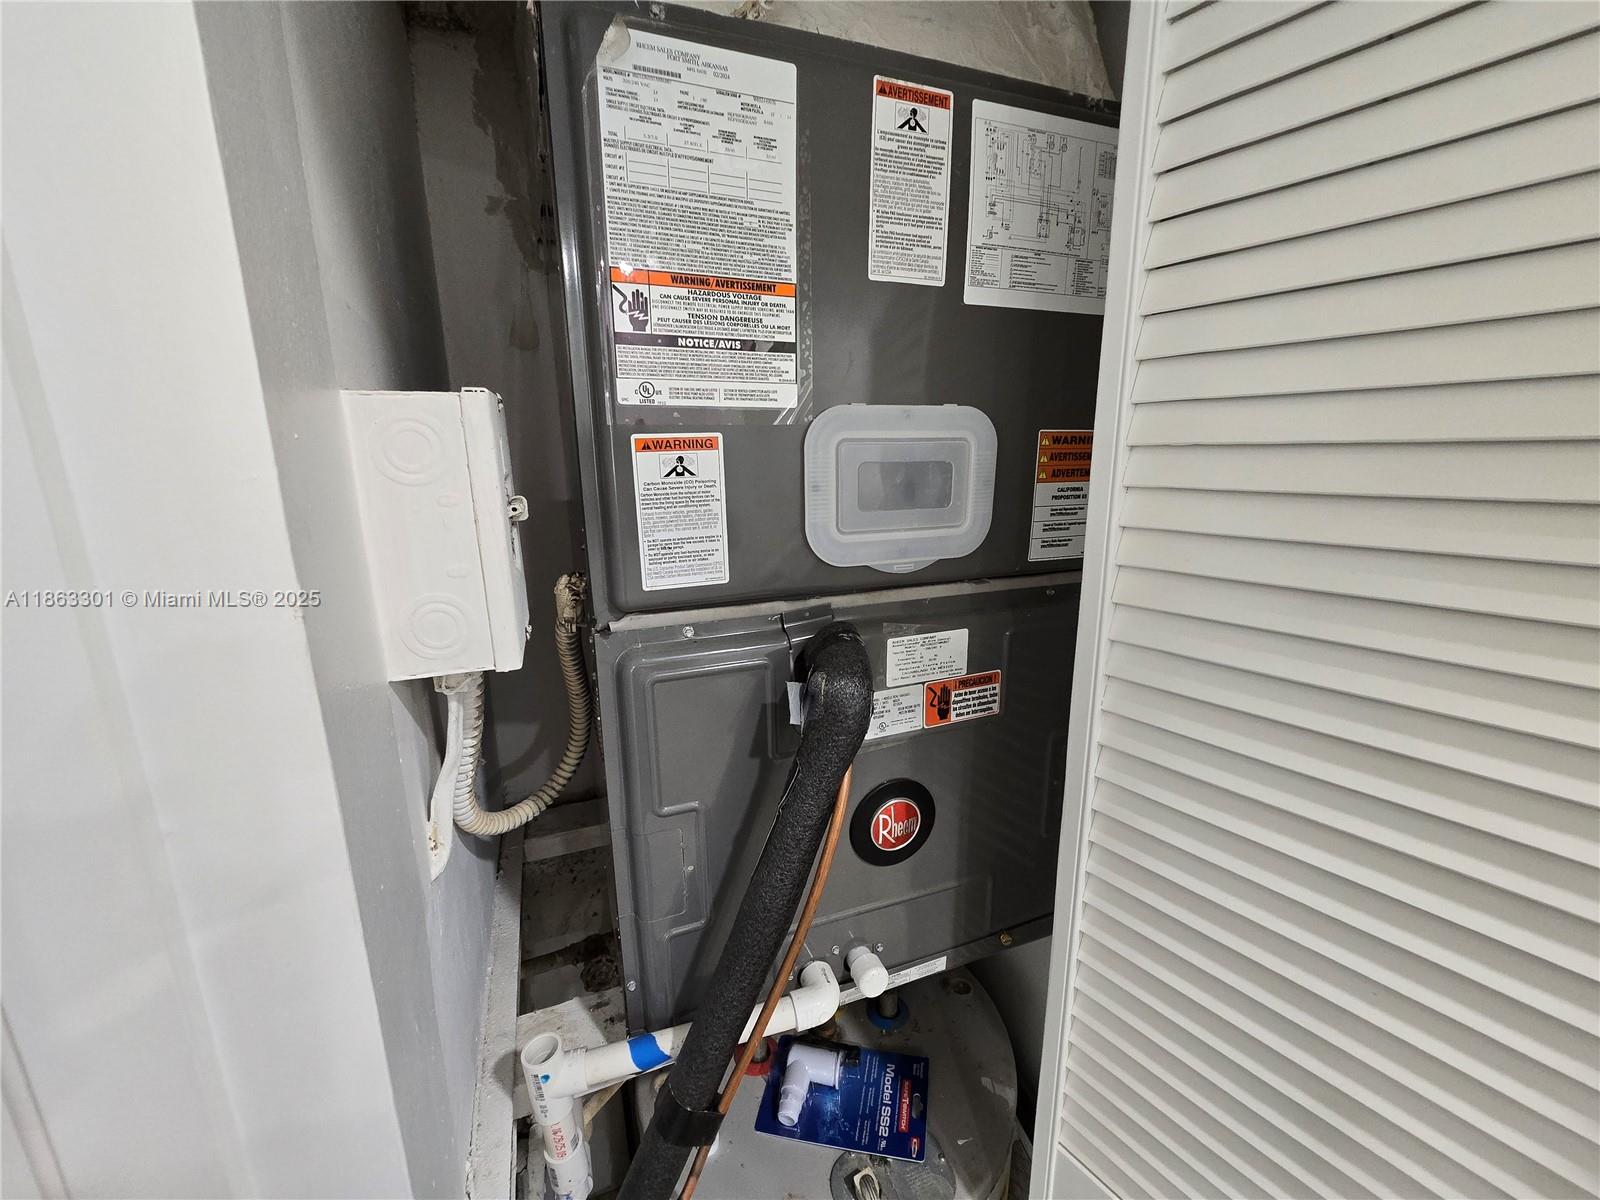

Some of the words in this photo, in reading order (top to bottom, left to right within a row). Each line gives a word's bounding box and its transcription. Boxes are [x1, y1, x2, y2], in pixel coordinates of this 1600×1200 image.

[888, 84, 948, 108] AVERTISSEMENT
[671, 275, 776, 293] WARNING/AVERTISSEMENT
[688, 289, 731, 299] HAZARDOUS
[733, 292, 761, 301] VOLTAGE
[687, 313, 718, 321] TENSION
[720, 315, 763, 324] DANGEREUSE
[726, 321, 760, 329] CORPORELLES
[678, 337, 741, 349] NOTICE/AVIS
[652, 439, 713, 449] WARNING
[878, 804, 918, 844] Rheem
[882, 1064, 896, 1104] Model
[879, 1106, 891, 1137] SS2
